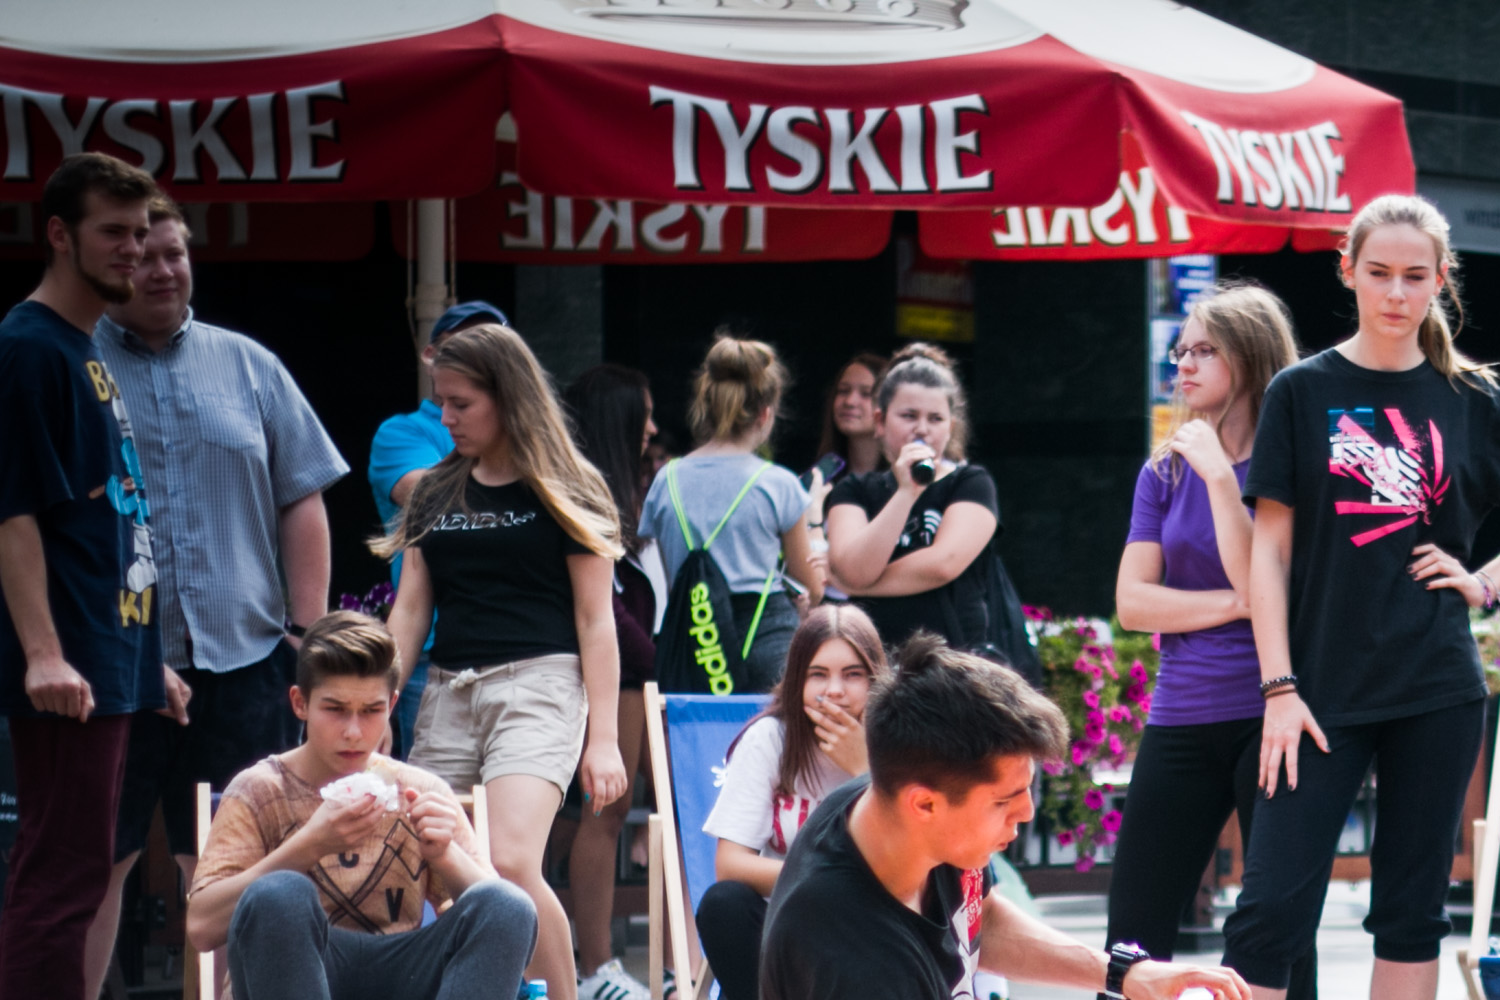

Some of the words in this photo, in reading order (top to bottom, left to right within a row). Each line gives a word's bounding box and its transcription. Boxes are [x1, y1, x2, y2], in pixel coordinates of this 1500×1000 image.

[0, 80, 347, 182] TYSKIE
[649, 85, 994, 193] TYSKIE
[1180, 110, 1352, 213] TYSKIE
[689, 582, 734, 696] adidas
